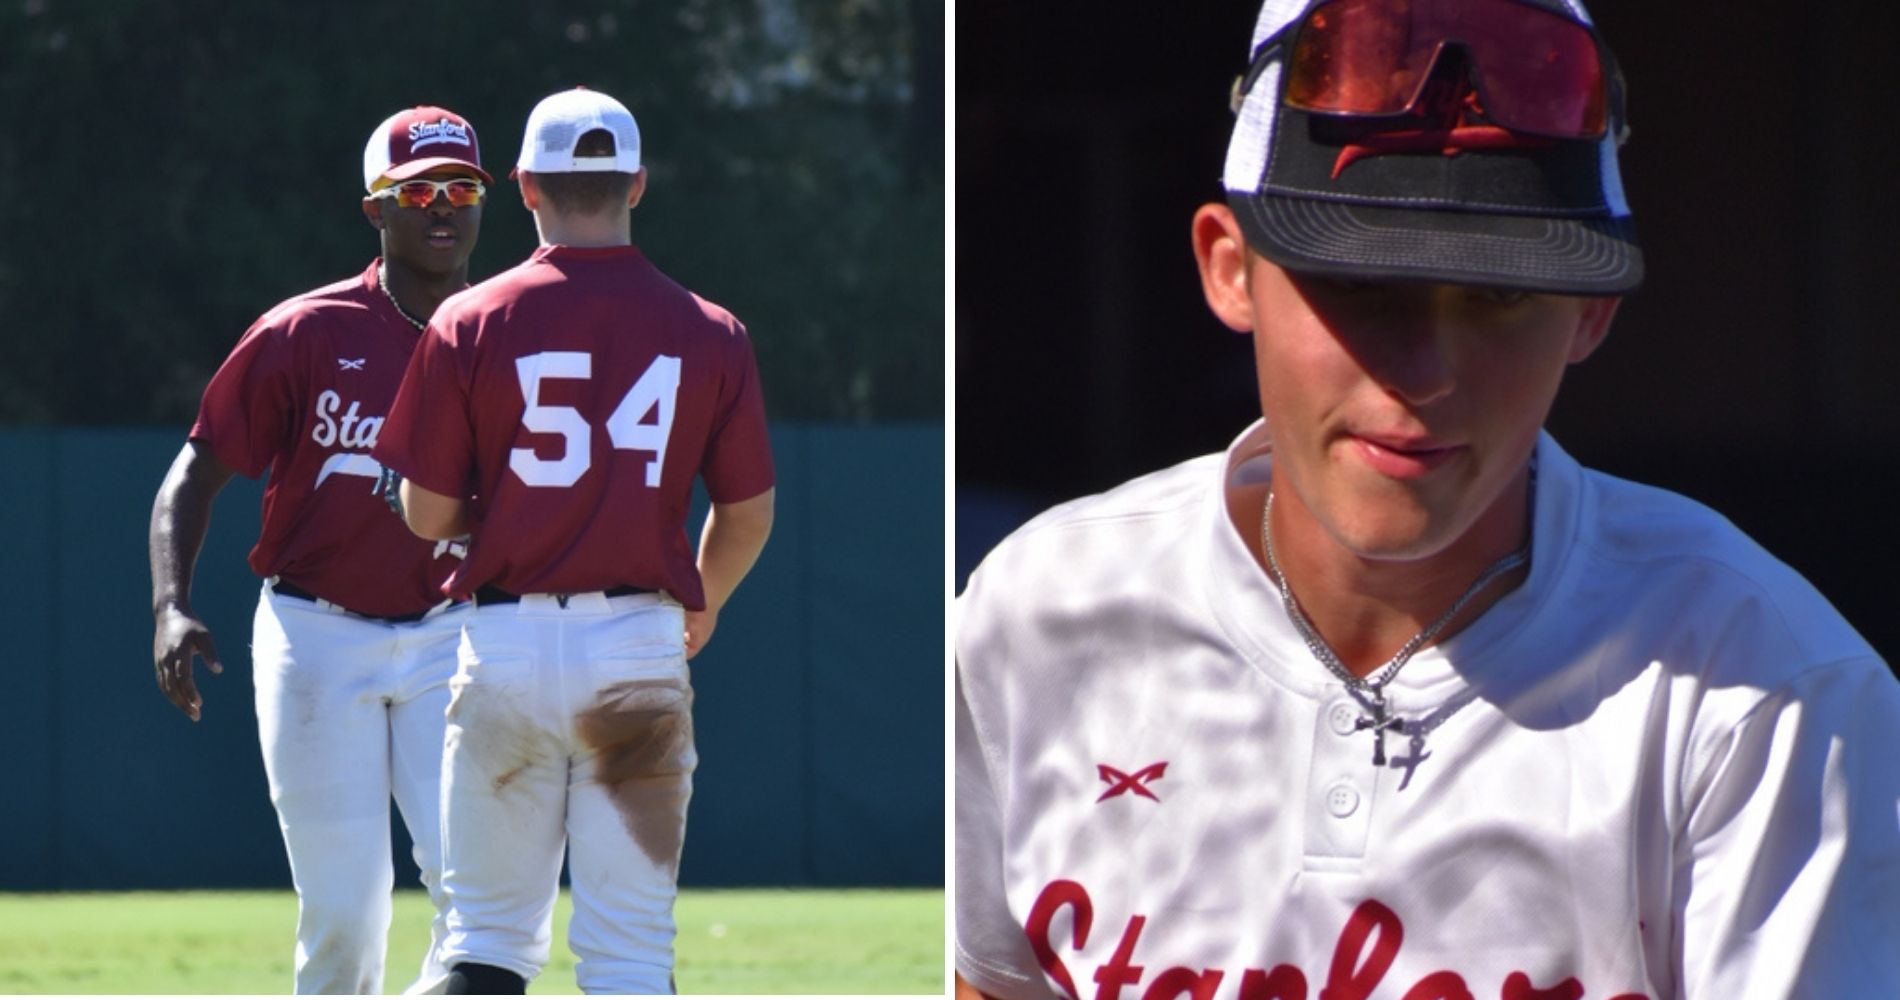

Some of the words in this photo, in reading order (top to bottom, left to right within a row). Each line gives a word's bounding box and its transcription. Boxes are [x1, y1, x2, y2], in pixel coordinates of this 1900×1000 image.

[409, 118, 466, 141] Stanford
[312, 389, 385, 449] Sta
[508, 351, 682, 488] 54
